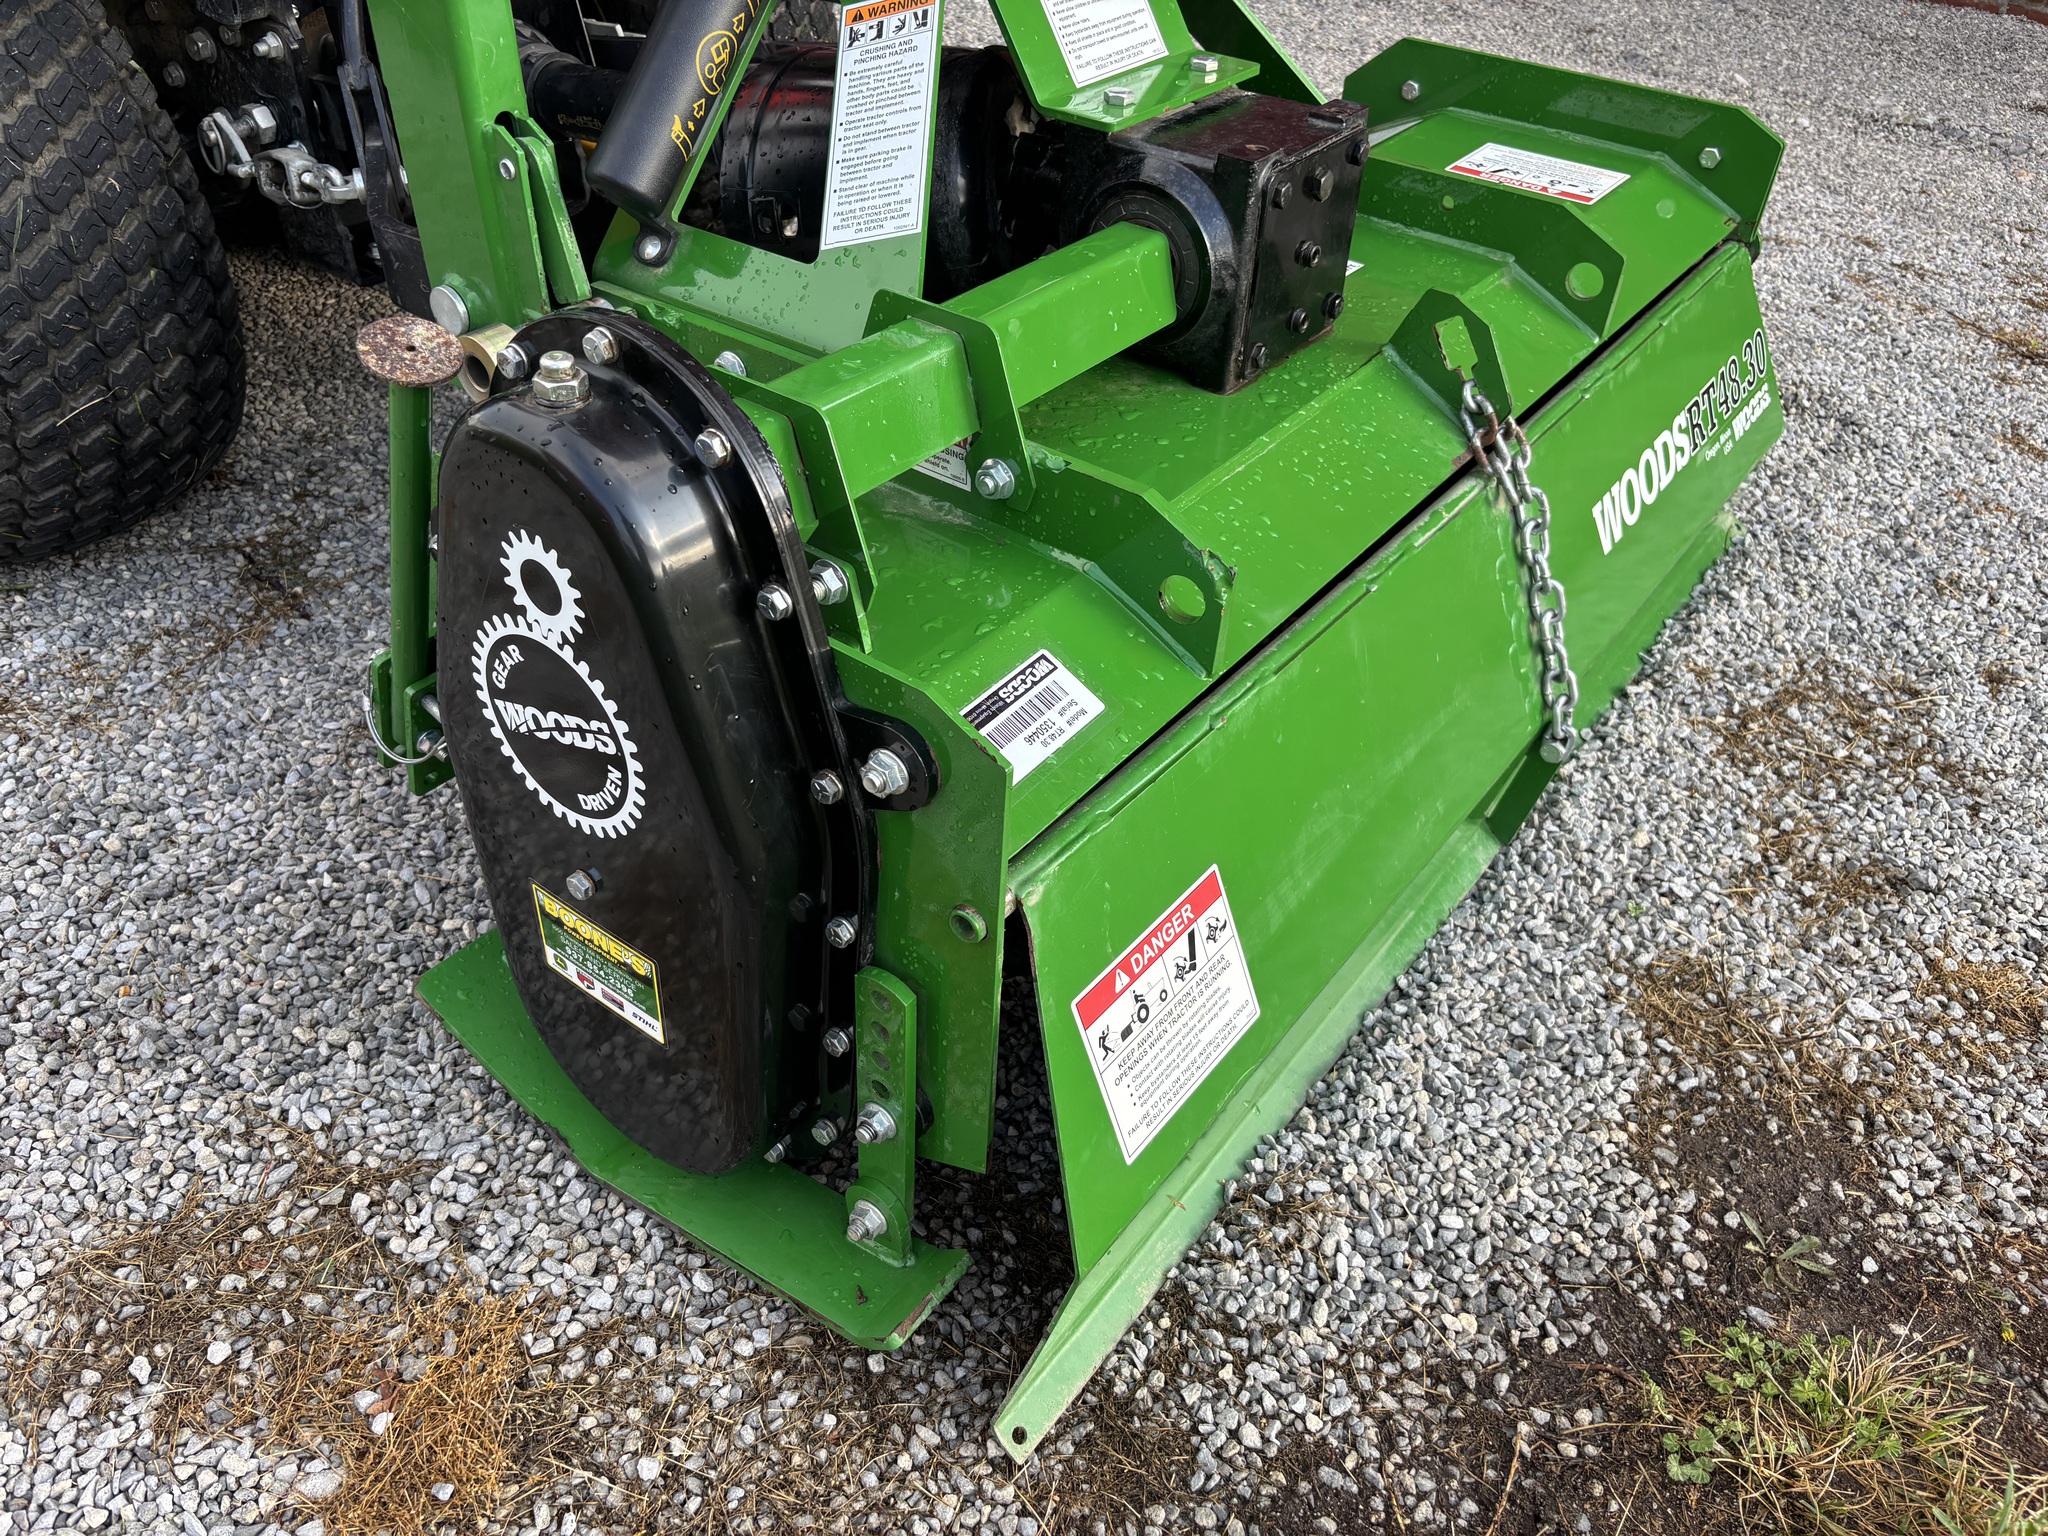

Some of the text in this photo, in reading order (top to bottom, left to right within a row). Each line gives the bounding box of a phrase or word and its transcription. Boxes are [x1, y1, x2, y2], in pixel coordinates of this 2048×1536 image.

[853, 45, 918, 65] PINCHING HAZARD
[857, 64, 883, 74] extremely
[884, 59, 902, 68] careful
[859, 38, 913, 56] CRUSHING AND
[845, 100, 867, 110] crushed
[875, 94, 897, 104] pinched
[898, 90, 921, 98] between
[848, 74, 871, 83] handling
[890, 85, 906, 93] could
[844, 117, 865, 125] Operate
[885, 108, 907, 116] controls
[1480, 172, 1542, 190] DANGER
[832, 222, 854, 231] RESULT
[862, 216, 888, 225] SERIOUS
[889, 212, 910, 220] INJURY
[833, 208, 856, 217] FAILURE
[867, 202, 892, 211] FOLLOW
[893, 197, 912, 206] THESE
[840, 206, 903, 222] INSTRUCTIONS COULD
[941, 448, 964, 460] SING
[1592, 328, 1767, 555] WOODS RT48.30
[492, 644, 524, 690] GEAR
[999, 659, 1054, 703] WOODS
[494, 698, 617, 755] WOODS
[1023, 698, 1078, 745] Serial# 1350446
[1040, 707, 1087, 747] Model# RT48.30
[578, 765, 622, 812] DRIVEN
[544, 897, 646, 976] BOONE'S
[564, 925, 584, 942] POWER
[1130, 903, 1195, 974] DANGER
[560, 936, 584, 956] SALES
[586, 952, 601, 967] AND
[603, 963, 636, 992] SERVICE
[632, 1012, 657, 1032] STIHL
[1114, 960, 1232, 1086] OPENINGS WHEN TRACTOR IS RUNNING.
[1117, 954, 1225, 1070] KEEP AWAY FROM FRONT AND REAR
[1131, 1062, 1150, 1082] Objects
[1150, 1052, 1159, 1063] can
[1159, 1044, 1166, 1053] be
[1165, 1027, 1182, 1046] thrown
[1181, 1020, 1188, 1028] by
[1188, 1002, 1206, 1022] rotating
[1134, 1069, 1153, 1091] Contact
[1153, 1059, 1164, 1071] with
[1163, 1039, 1182, 1060] rotating
[1181, 1023, 1196, 1040] blades
[1196, 1012, 1205, 1024] will
[1204, 999, 1218, 1015] cause
[1137, 999, 1229, 1101] Keep bystanders at least 15 feet away from
[1127, 999, 1249, 1137] FAILURE TO FOLLOW THESE INSTRUCTIONS COULD
[1140, 1078, 1164, 1107] equipment
[1164, 1062, 1180, 1080] during
[1145, 1023, 1238, 1128] RESULT IN SERIOUS INJURY OR DEATH.
